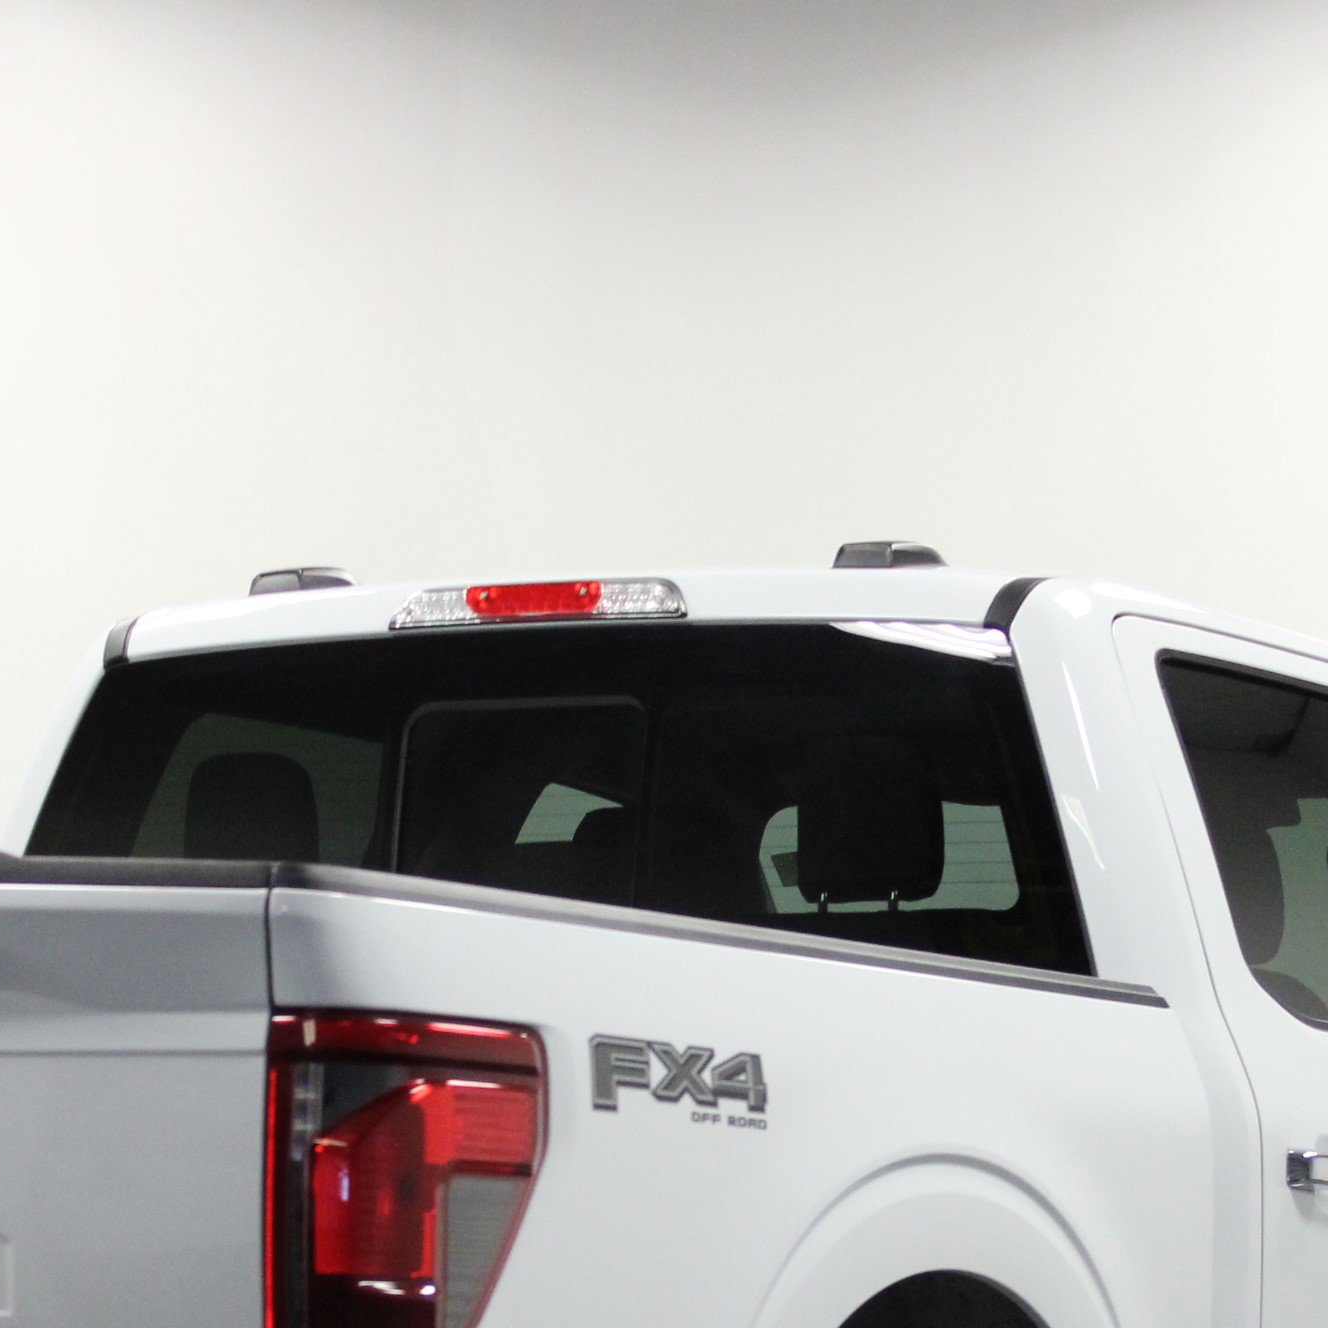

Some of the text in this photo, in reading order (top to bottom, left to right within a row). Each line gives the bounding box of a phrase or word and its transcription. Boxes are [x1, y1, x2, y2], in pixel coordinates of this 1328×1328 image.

[589, 1033, 768, 1113] FX4
[691, 1111, 768, 1130] OFF ROAD
